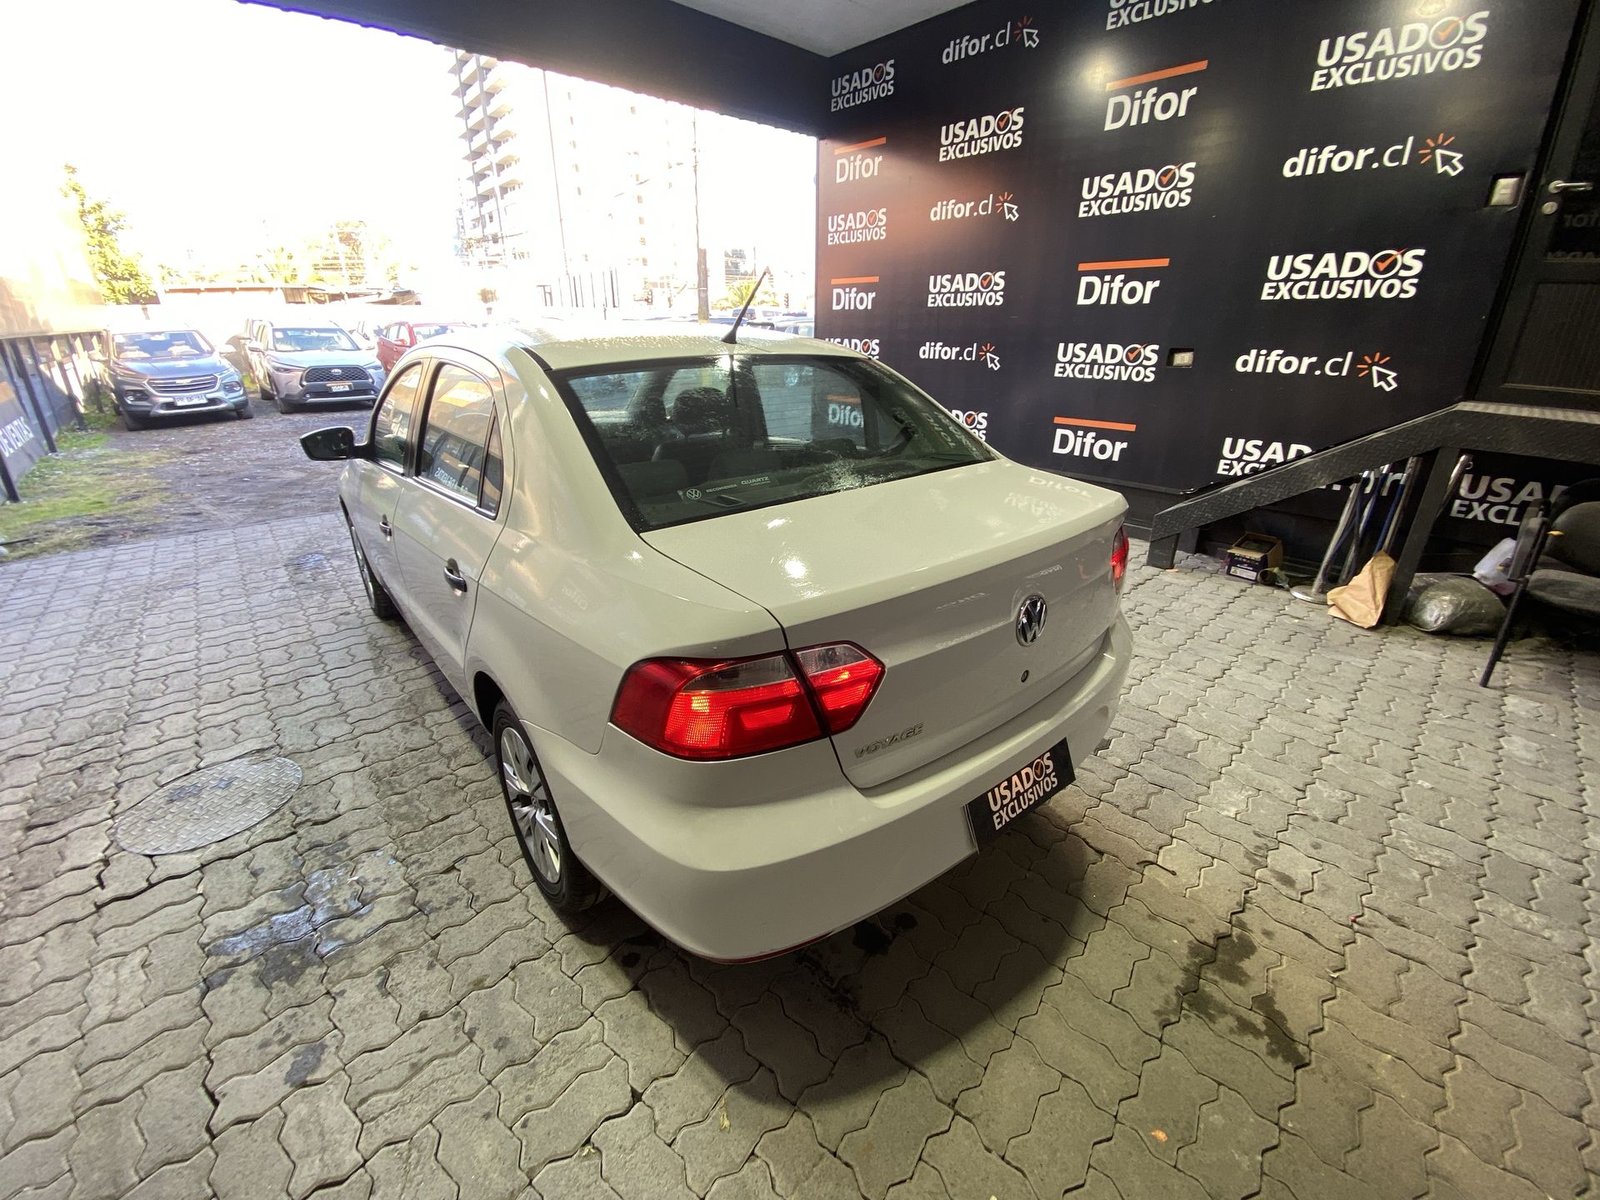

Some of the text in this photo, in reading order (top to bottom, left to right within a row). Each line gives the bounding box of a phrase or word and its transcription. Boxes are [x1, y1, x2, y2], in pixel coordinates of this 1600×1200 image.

[1106, 0, 1214, 31] EXCLUSI
[942, 22, 1011, 65] difor.cl
[1317, 11, 1490, 67] USADOS
[832, 60, 895, 97] USADOS
[1310, 44, 1483, 92] EXCLUSIVOS
[831, 80, 895, 113] EXCLUSIVOS
[1103, 87, 1198, 132] Difor
[941, 107, 1025, 145] USADOS
[939, 131, 1023, 162] EXCLUSIVOS
[1282, 136, 1414, 178] difor.cl
[835, 154, 883, 184] Difor
[1081, 162, 1197, 200] USADOS
[930, 194, 993, 222] difor.cl
[1078, 188, 1193, 218] EXCLUSIVOS
[828, 208, 887, 233] USADOS
[828, 226, 887, 246] EXCLUSIVOS
[1267, 248, 1426, 281] USADOS
[929, 271, 1006, 294] USADOS
[1076, 274, 1161, 306] Difor
[1260, 278, 1418, 301] EXCLUSIVOS
[832, 287, 877, 311] Difor
[928, 292, 1005, 308] EXCLUSIVOS
[824, 337, 881, 355] ADOS
[919, 341, 977, 361] difor.cl
[1057, 342, 1160, 367] USADOS
[1053, 363, 1157, 383] EXCLUSIVOS
[1235, 350, 1354, 377] difor.cl
[1052, 428, 1129, 463] Difor
[741, 476, 770, 485] QUARTZ
[987, 751, 1054, 812] USADOS
[992, 771, 1059, 831] EXCLUSIVOS
